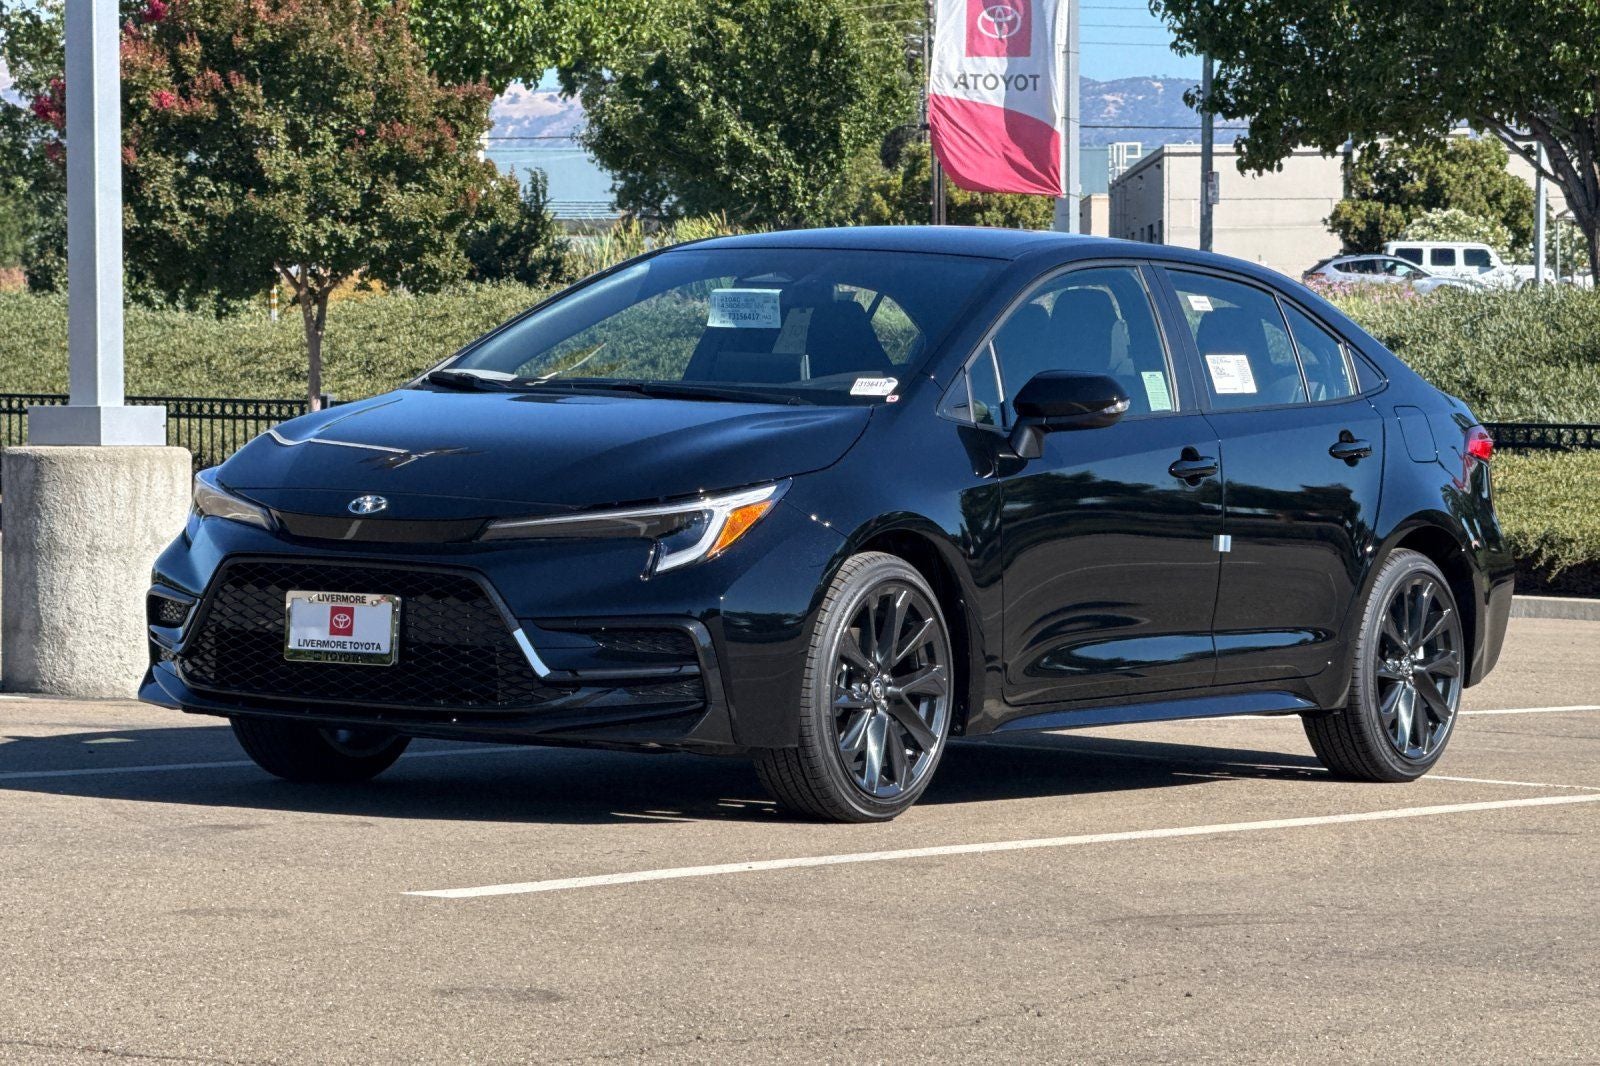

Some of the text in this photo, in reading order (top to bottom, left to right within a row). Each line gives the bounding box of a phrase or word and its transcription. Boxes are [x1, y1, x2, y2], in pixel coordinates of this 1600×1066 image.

[317, 593, 367, 604] LIVERMORE
[298, 639, 381, 651] LIVERMORE TOYOTA
